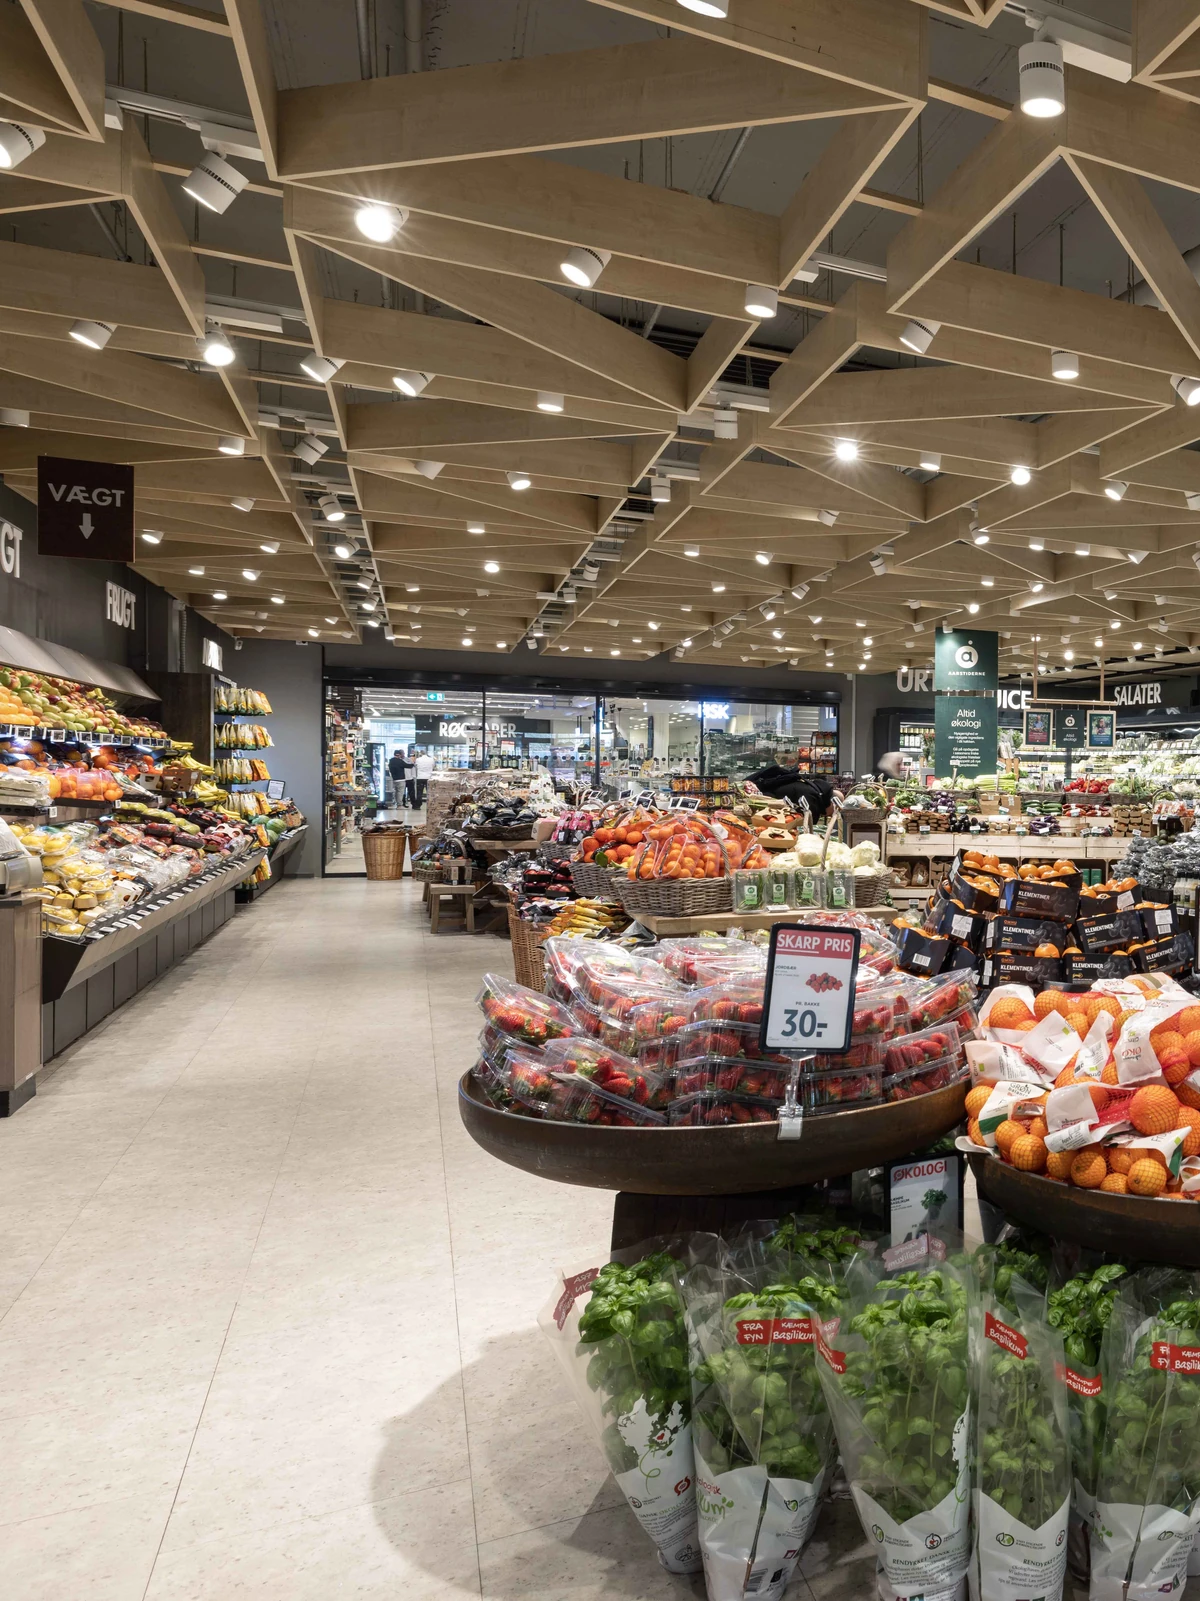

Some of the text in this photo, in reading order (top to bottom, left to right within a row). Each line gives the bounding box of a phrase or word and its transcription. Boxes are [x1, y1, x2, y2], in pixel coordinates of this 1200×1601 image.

[47, 482, 125, 507] VÆGT
[106, 580, 136, 630] FRUGT
[1114, 682, 1162, 707] SALATER
[957, 709, 976, 717] Altid
[951, 719, 982, 729] økologi
[1018, 891, 1050, 900] KLEMENTINER
[1003, 926, 1035, 935] KLEMENTINER
[1084, 923, 1114, 933] KLEMENTINER
[777, 934, 851, 952] SKARP PRIS
[1146, 948, 1173, 960] KLEMENTINER
[893, 1161, 947, 1182] ØKOLOGI
[743, 1322, 763, 1331] FRA
[996, 1323, 1018, 1341] KÆMPE
[743, 1333, 763, 1342] FYN
[773, 1331, 816, 1340] Basilikum
[990, 1328, 1024, 1357] Basilikum
[1068, 1371, 1093, 1387] KÆMPE
[1066, 1379, 1101, 1395] asilikum
